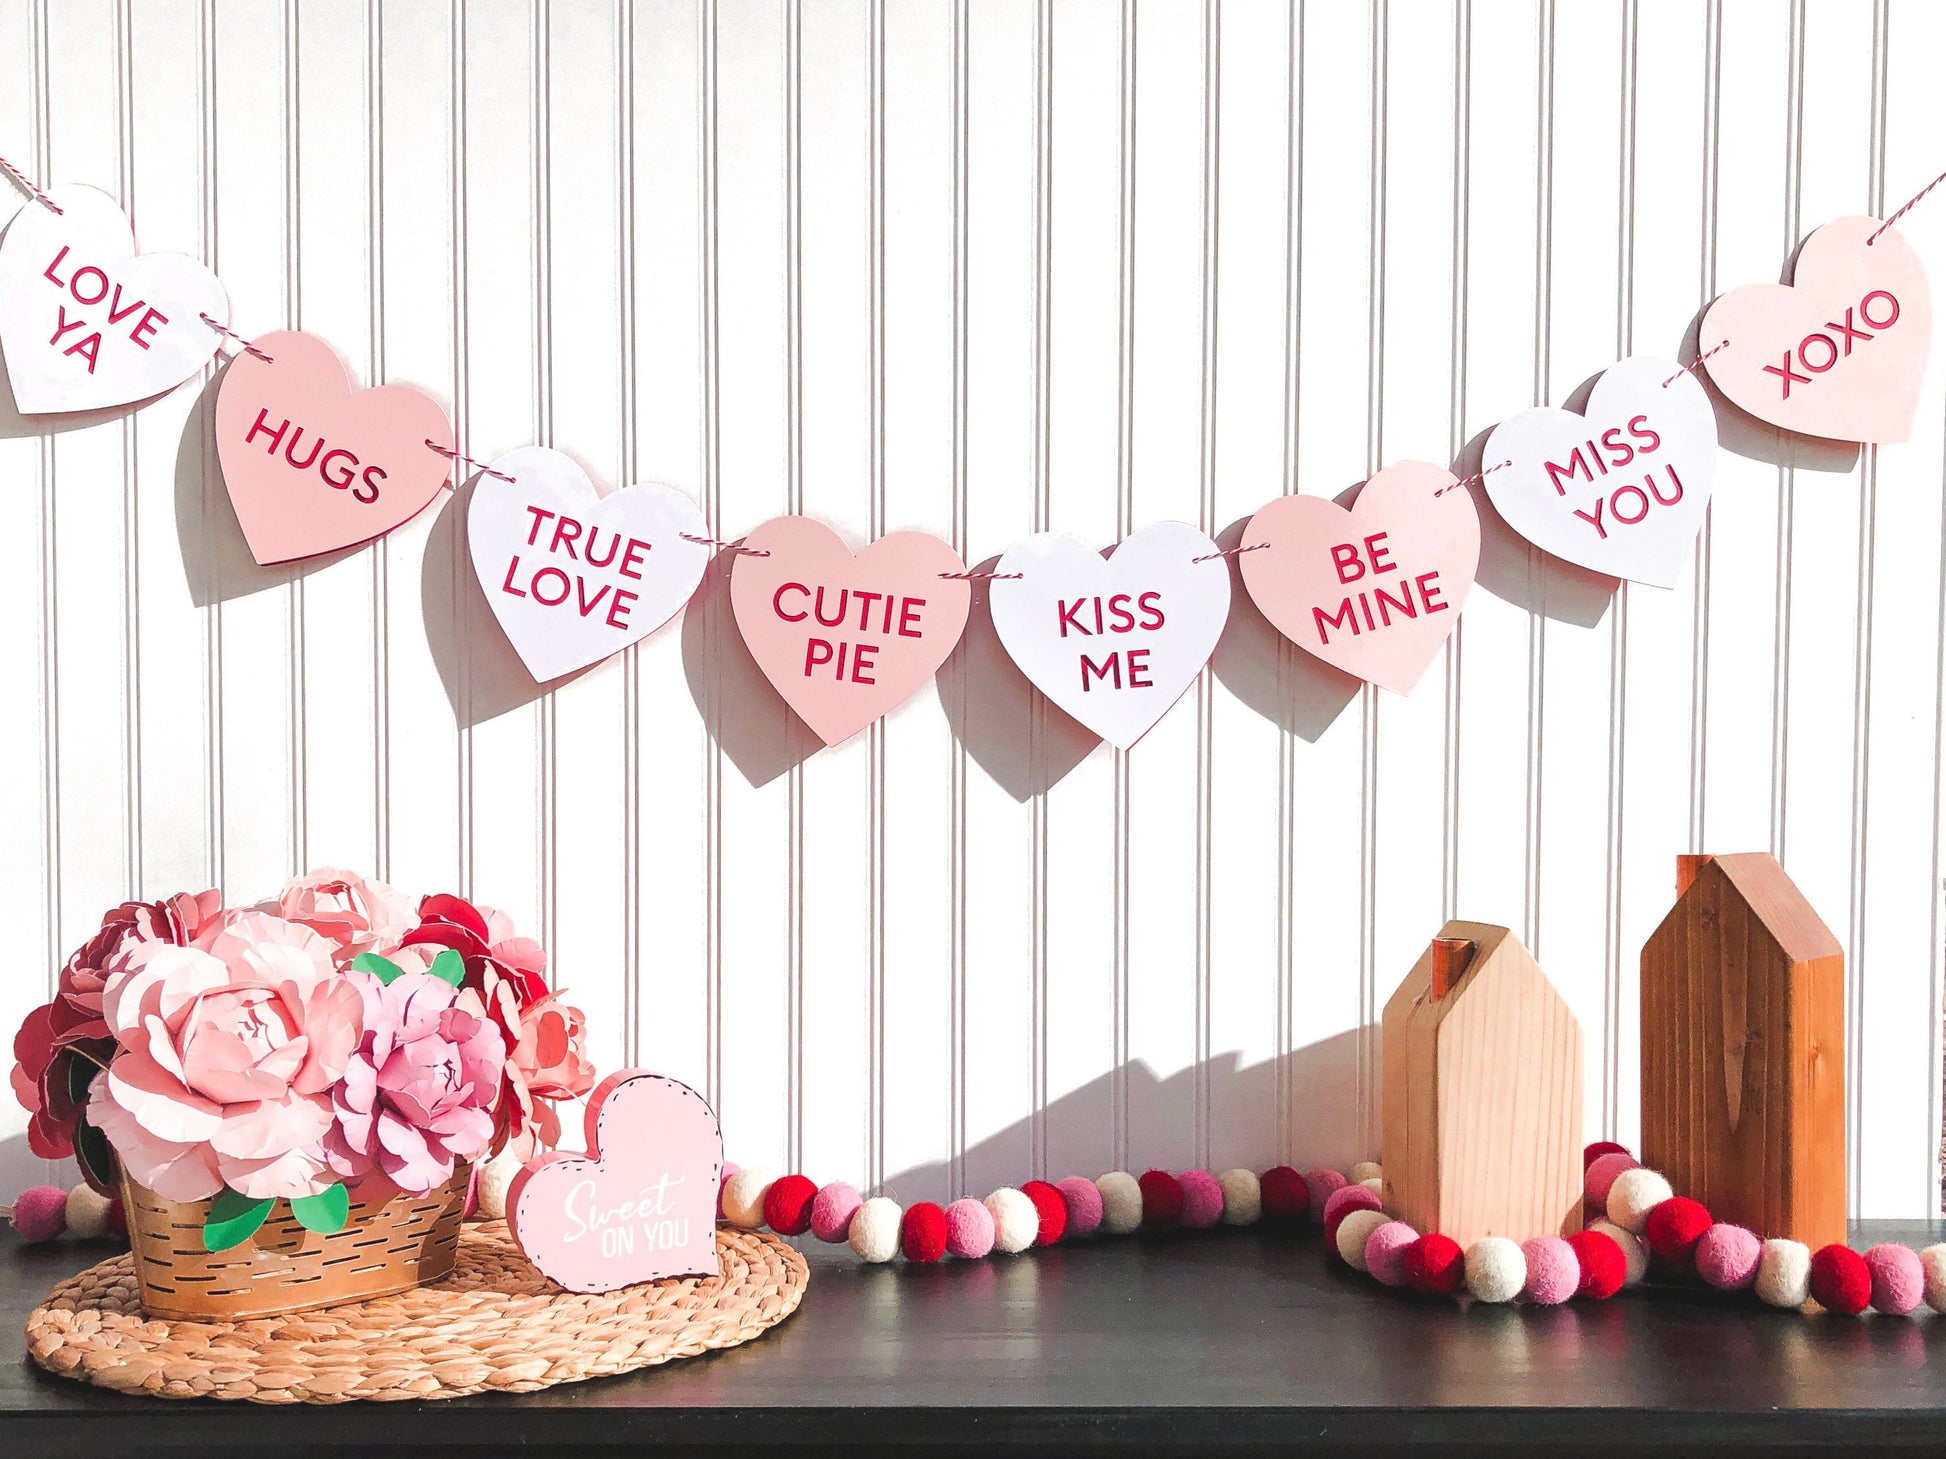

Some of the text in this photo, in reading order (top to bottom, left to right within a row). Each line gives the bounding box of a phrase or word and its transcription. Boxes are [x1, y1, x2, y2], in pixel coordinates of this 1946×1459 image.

[43, 245, 169, 351] LOVE
[49, 306, 102, 375] YA
[1763, 290, 1900, 400] XOXO
[244, 407, 388, 506] HUGS
[1544, 414, 1661, 497] MISS
[1572, 463, 1684, 540] YOU
[526, 505, 652, 581] TRUE
[1330, 530, 1398, 586] BE
[502, 555, 639, 631] LOVE
[772, 581, 928, 639] CUTIE
[1057, 591, 1166, 639] KISS
[1311, 570, 1450, 646] MINE
[803, 637, 880, 687] PIE
[1080, 649, 1153, 692] ME
[563, 1173, 687, 1243] Sweet
[601, 1217, 689, 1258] ON YOU
